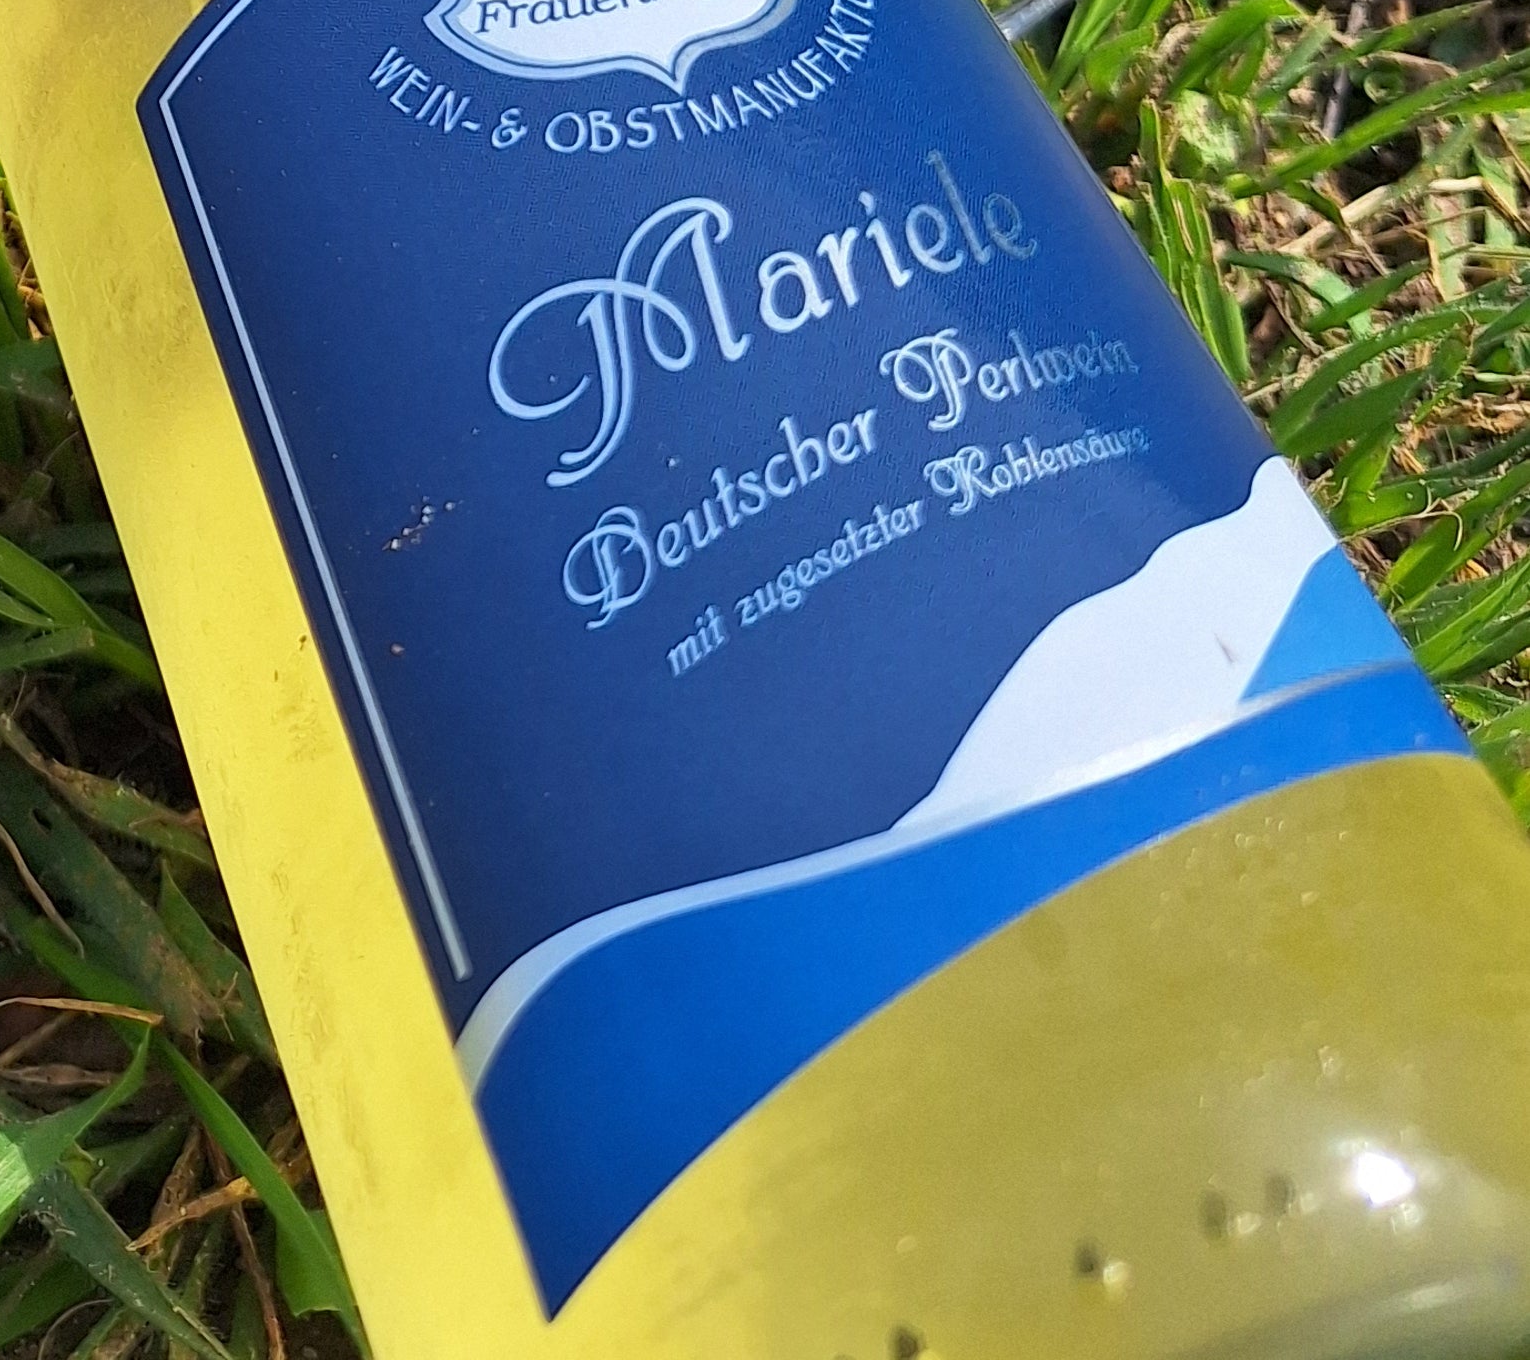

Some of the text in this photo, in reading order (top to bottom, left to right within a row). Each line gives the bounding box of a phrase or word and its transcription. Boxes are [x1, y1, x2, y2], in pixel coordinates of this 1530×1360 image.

[368, 45, 481, 135] WEIN-
[490, 107, 529, 151] &
[488, 149, 1038, 488] Mariele
[561, 328, 1139, 630] Deutscher Perlwein
[665, 604, 728, 678] mit
[734, 499, 927, 626] zugesetzter
